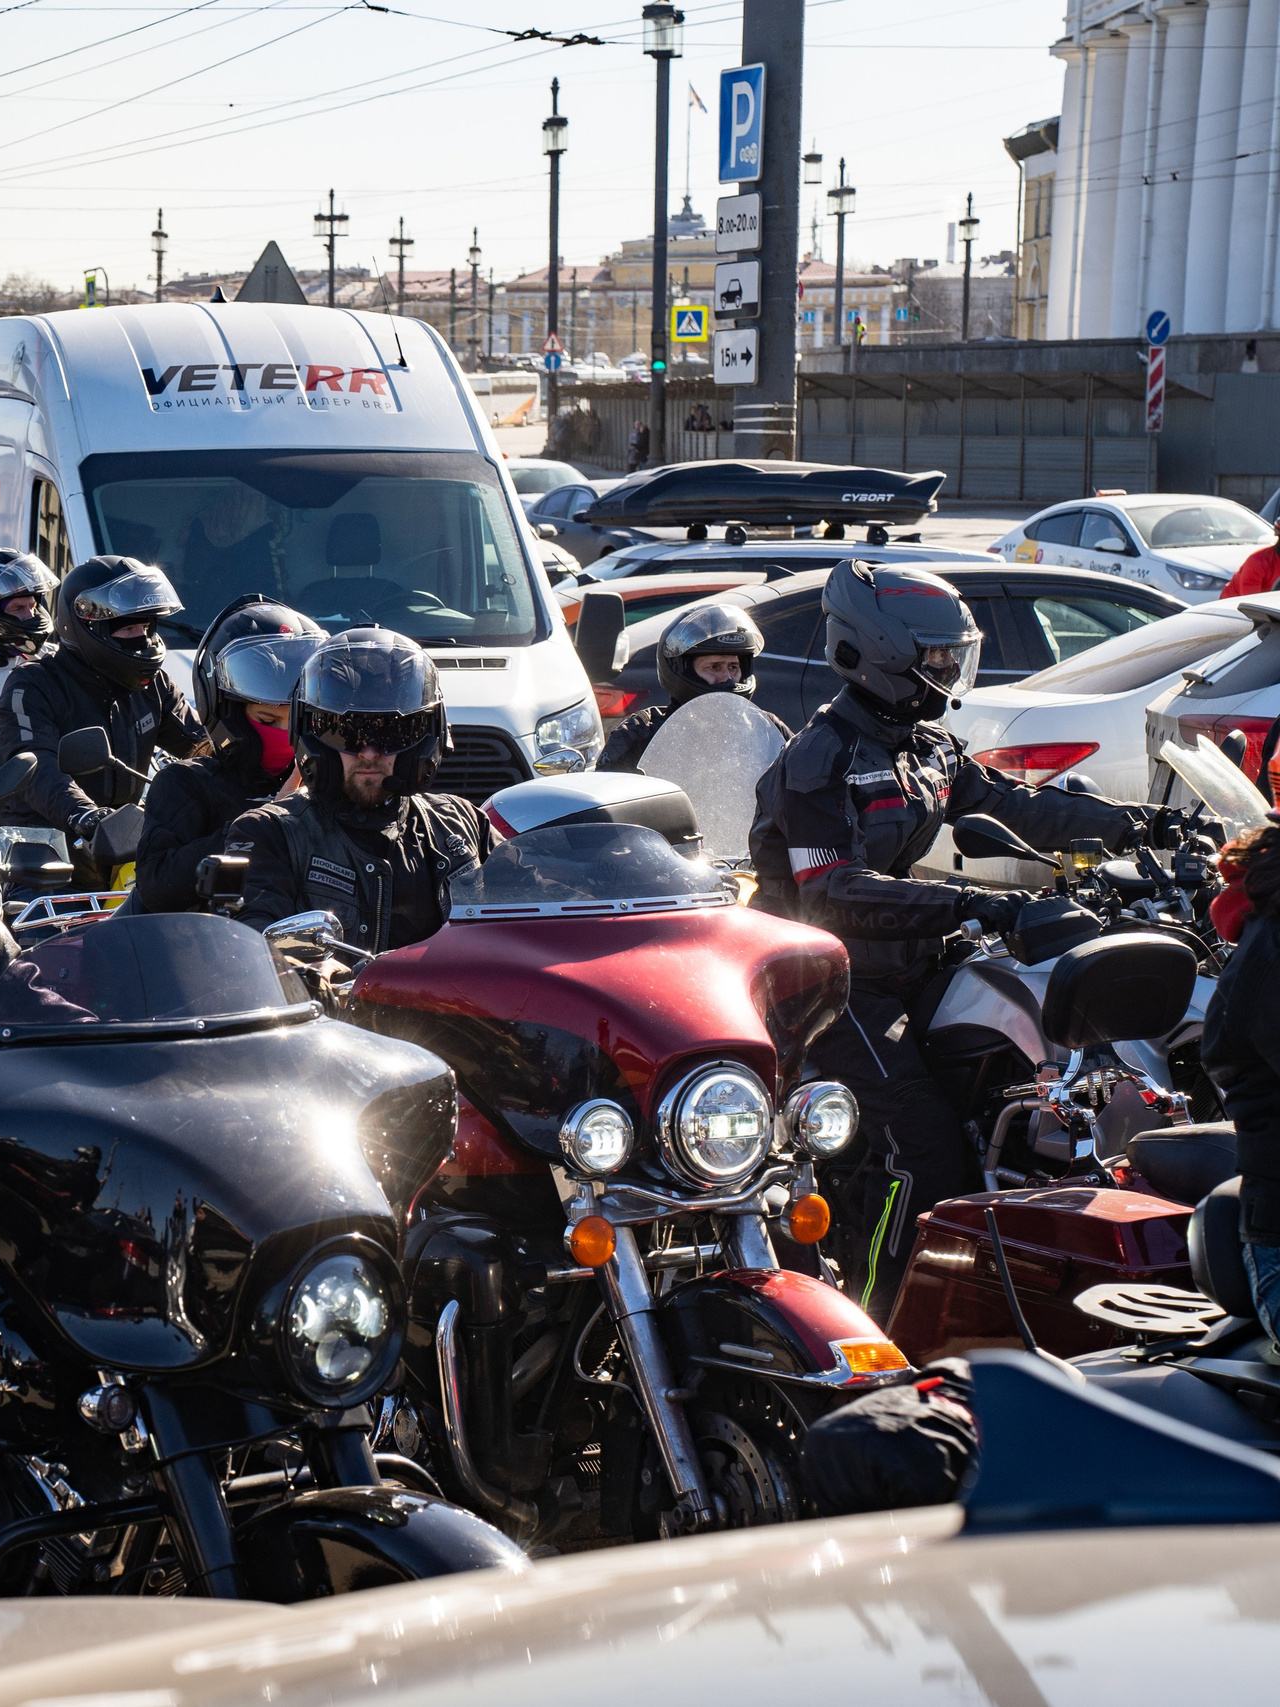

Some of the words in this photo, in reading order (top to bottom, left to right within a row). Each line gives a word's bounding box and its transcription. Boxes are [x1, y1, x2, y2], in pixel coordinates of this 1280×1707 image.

[730, 81, 755, 168] P
[718, 213, 758, 235] 8.00-20.00
[141, 363, 389, 396] VETERR
[153, 395, 286, 411] ОФИЦИАЛЬНЫЙ
[297, 396, 352, 408] ДИЛЕР
[363, 399, 393, 410] BRP
[841, 493, 896, 502] CYBORT
[227, 841, 256, 852] S2
[312, 857, 356, 879] HOOLIGANS
